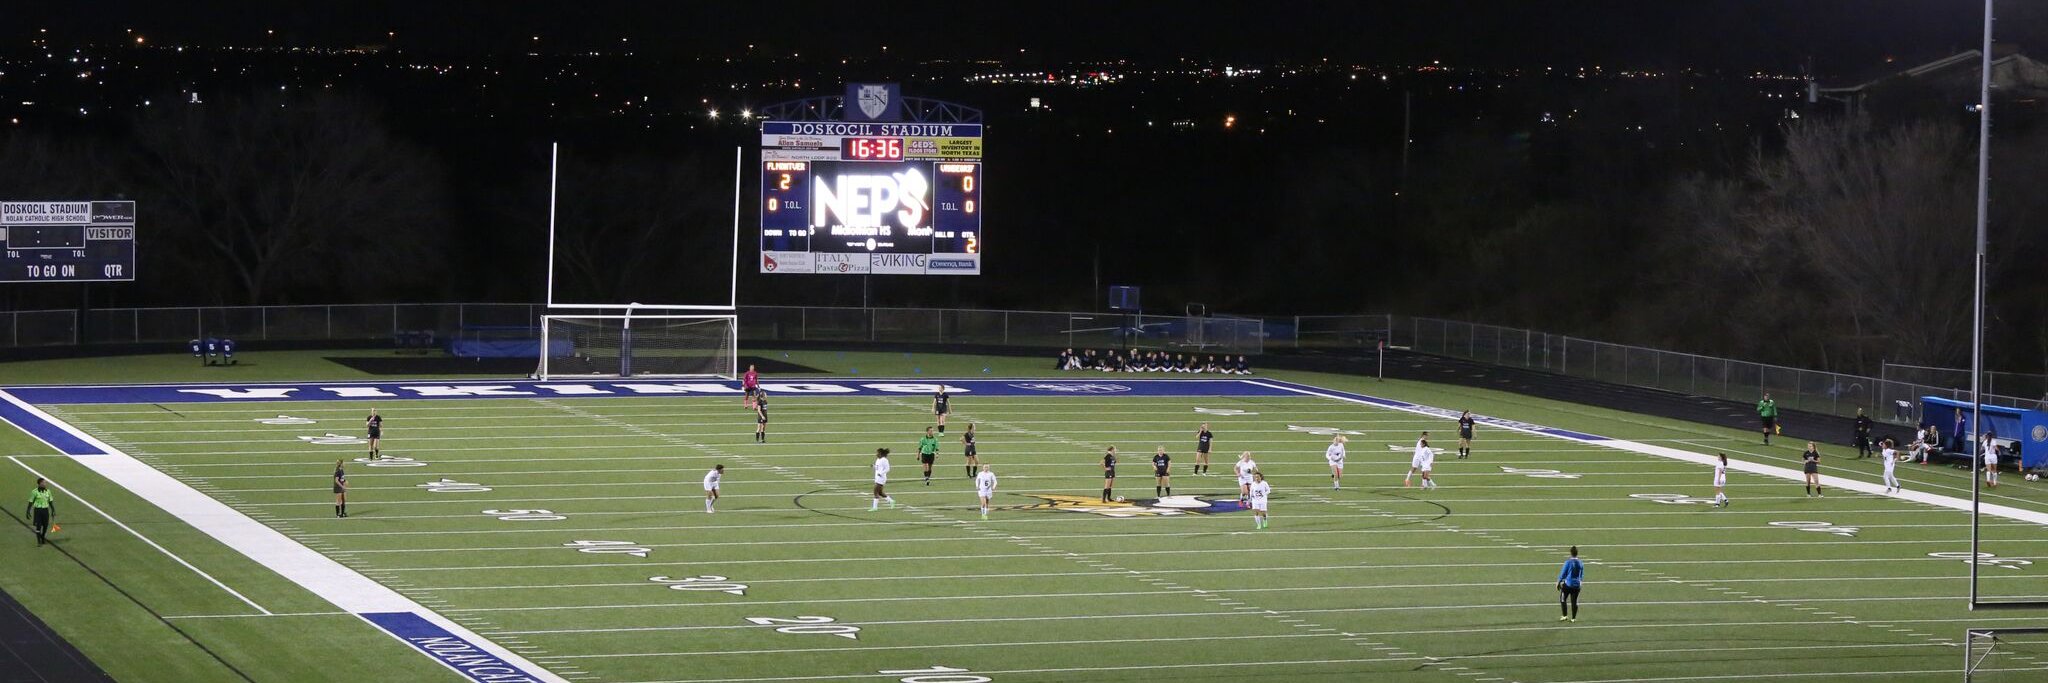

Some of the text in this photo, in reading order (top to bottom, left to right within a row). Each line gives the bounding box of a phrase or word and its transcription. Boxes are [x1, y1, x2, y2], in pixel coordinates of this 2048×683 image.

[792, 123, 953, 137] DOSKOCIL STADIUM
[851, 139, 900, 158] 16:36
[780, 173, 790, 190] 2
[963, 175, 973, 192] 0
[3, 203, 88, 214] DOSKOCIL STADIUM
[768, 198, 777, 211] 0
[784, 201, 801, 209] T.O.L.
[965, 200, 974, 213] 0
[65, 214, 86, 222] SCHOOL
[87, 228, 132, 239] VISITOR
[966, 238, 977, 254] 2
[72, 250, 86, 258] TOL
[817, 254, 852, 263] ITALY
[880, 254, 926, 268] VIKING
[27, 265, 75, 278] TO GO ON
[104, 264, 122, 278] QTR
[816, 263, 839, 272] Pasta
[848, 264, 871, 272] Pizza
[176, 382, 972, 399] VIKINGS
[648, 575, 748, 591] 30
[744, 615, 861, 634] 20
[409, 636, 503, 667] NOLAN
[877, 665, 993, 683] 10
